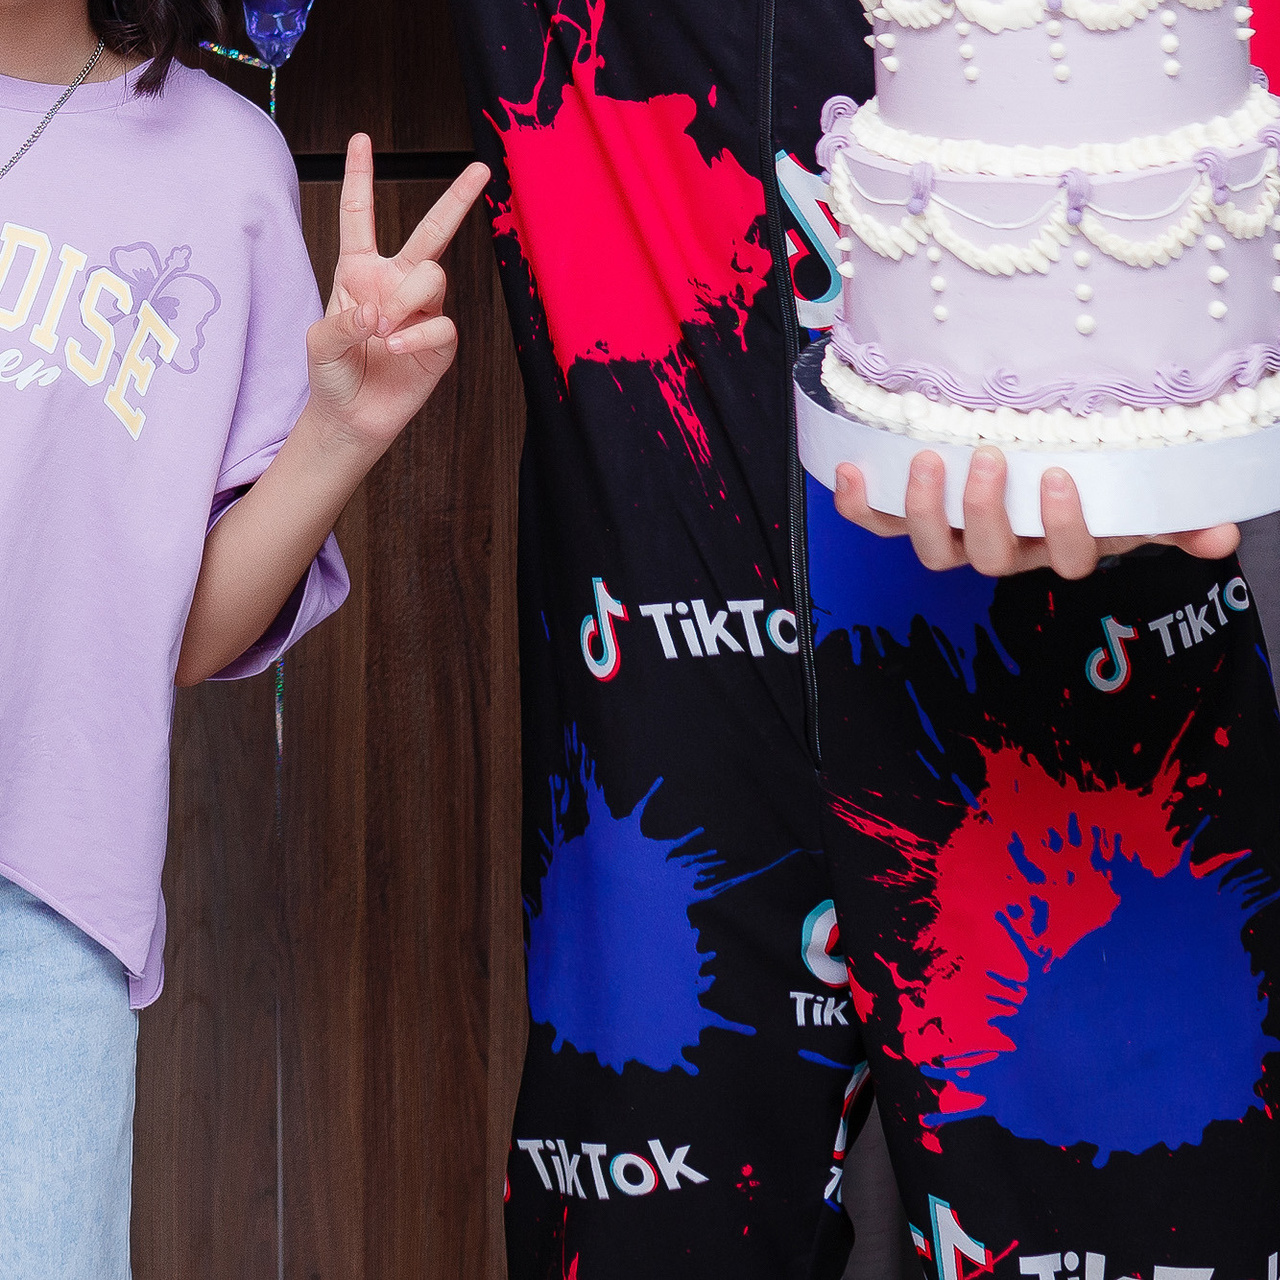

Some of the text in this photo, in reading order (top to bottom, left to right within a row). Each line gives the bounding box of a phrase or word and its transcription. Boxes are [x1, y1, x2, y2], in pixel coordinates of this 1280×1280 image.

[638, 598, 799, 660] TikTo
[1147, 576, 1250, 658] TikTo
[789, 991, 853, 1027] Tik
[517, 1138, 710, 1200] TikTok
